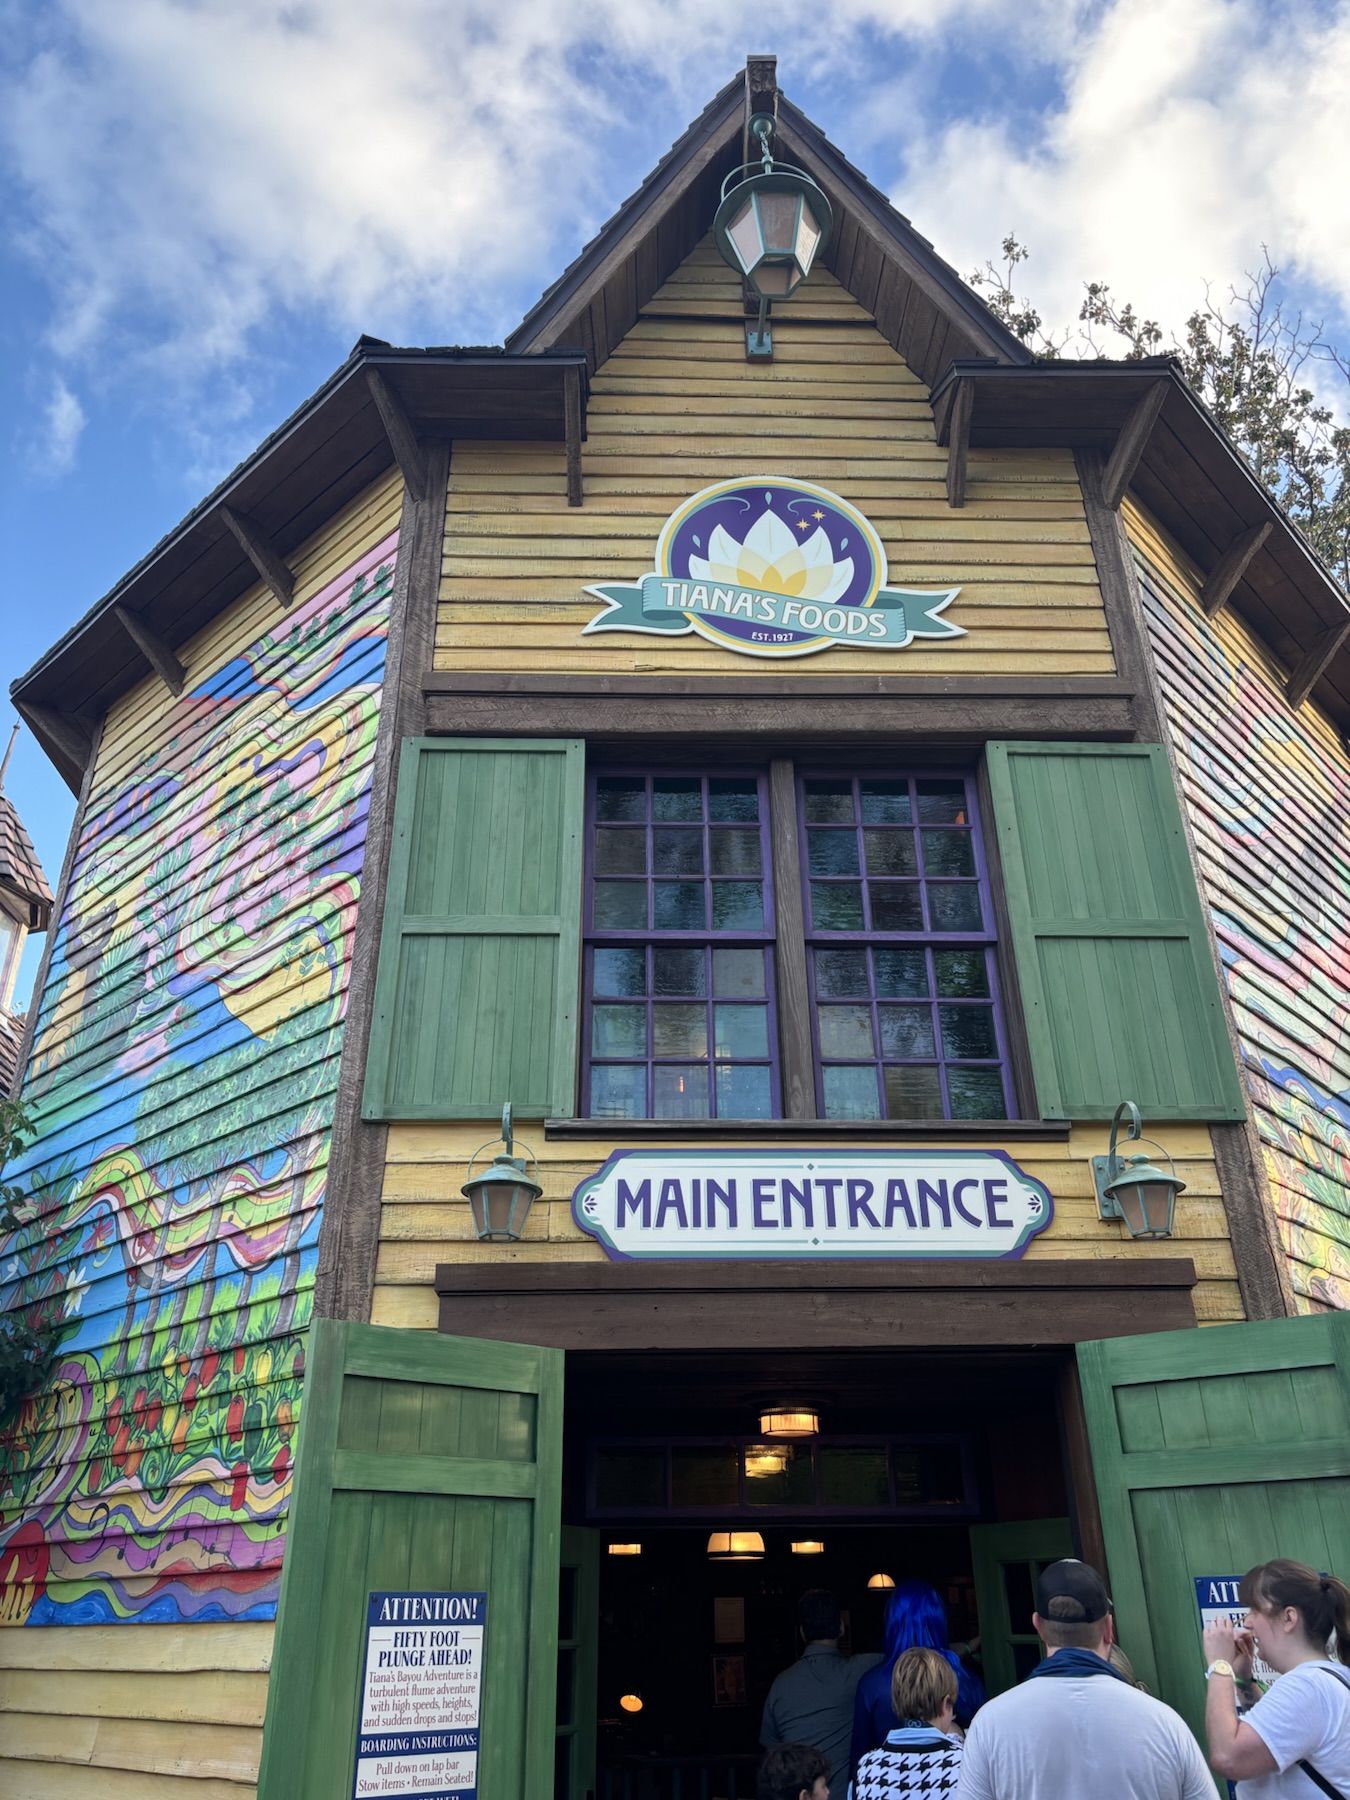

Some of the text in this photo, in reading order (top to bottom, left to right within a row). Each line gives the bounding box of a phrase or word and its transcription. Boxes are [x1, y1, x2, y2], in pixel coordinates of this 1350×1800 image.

[661, 582, 888, 638] TIANA'S FOODS
[615, 1178, 1015, 1230] MAIN ENTRANCE
[379, 1597, 478, 1621] ATTENTION!
[393, 1630, 461, 1648] FIFTY FOOT
[378, 1648, 473, 1668] PLUNGE AHEAD!
[369, 1669, 479, 1684] Tiana's Bayou Adventure is a
[369, 1682, 476, 1698] turbulent flume adventure
[370, 1695, 473, 1714] with high speeds, heights,
[363, 1709, 478, 1728] and sudden drops and stops!
[360, 1733, 478, 1754] BOARDING INSTRUCTIONS:
[376, 1757, 460, 1776] Pull down on lap bar
[358, 1770, 474, 1792] Stow items Remain Seated!
